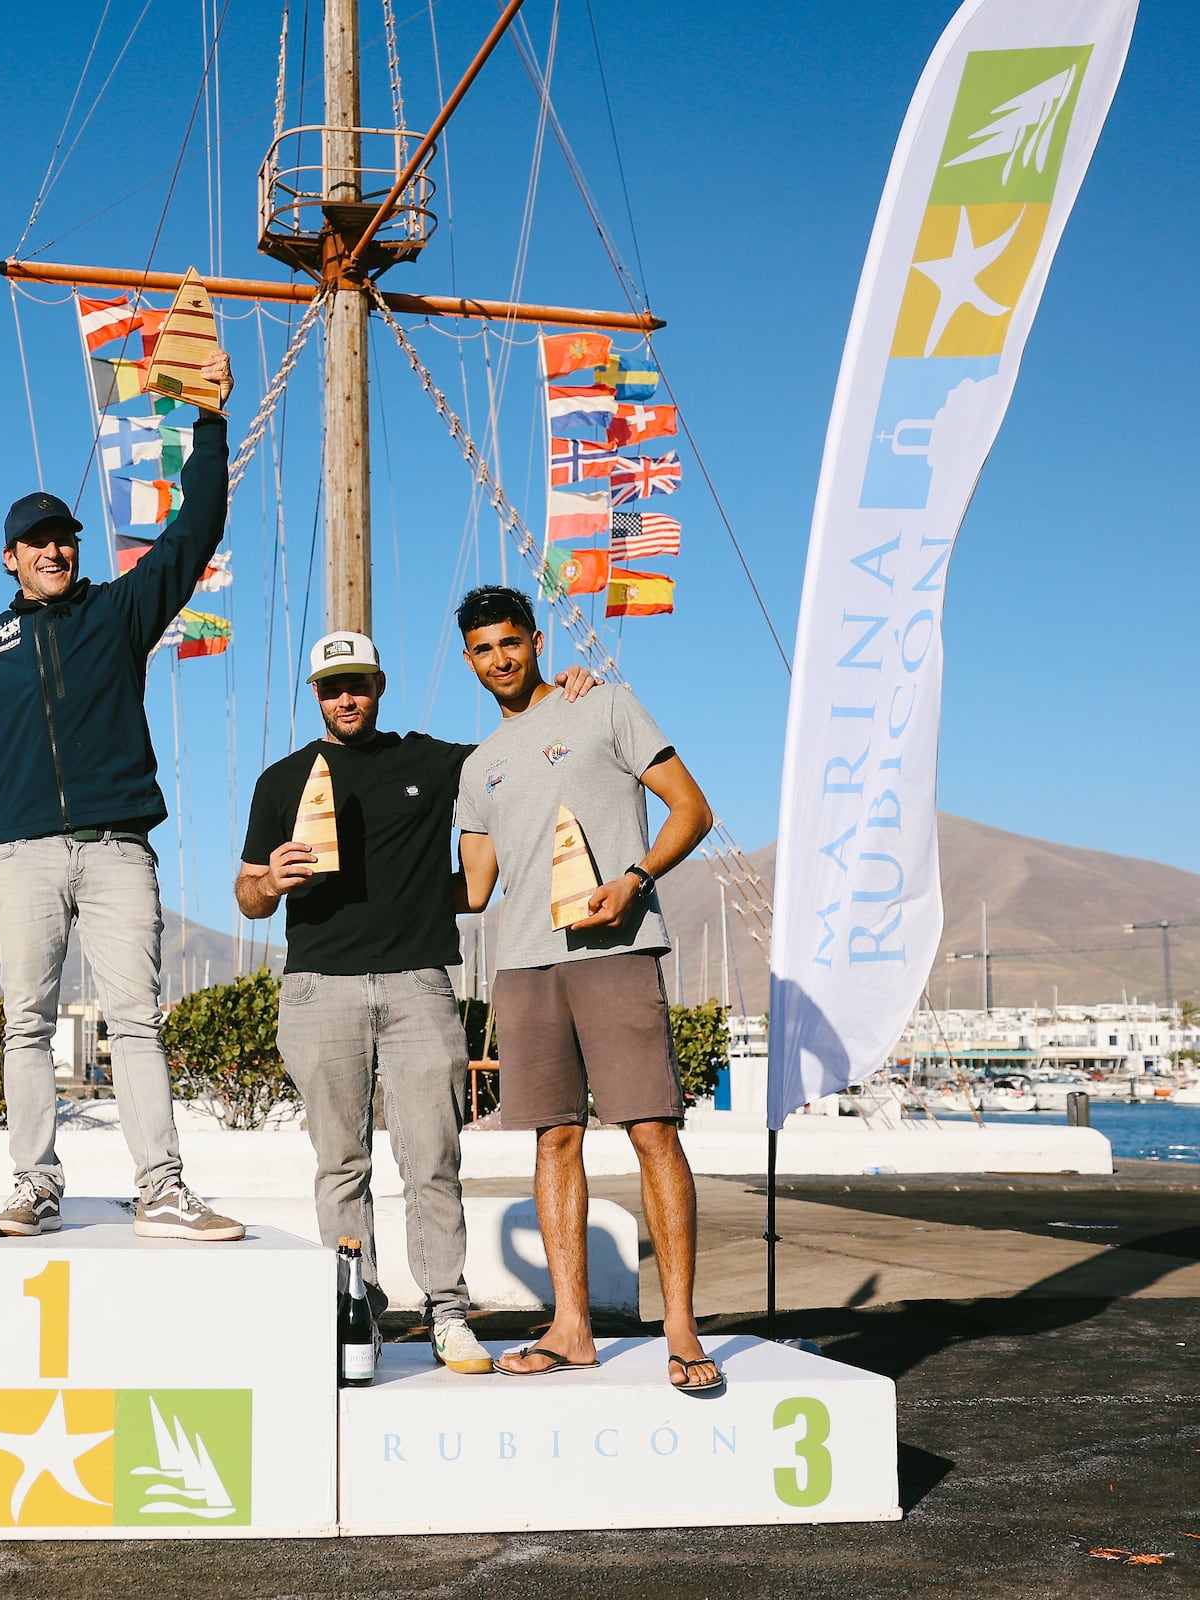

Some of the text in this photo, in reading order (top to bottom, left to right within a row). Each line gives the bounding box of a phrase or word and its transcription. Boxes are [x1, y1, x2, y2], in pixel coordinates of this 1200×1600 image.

[812, 529, 903, 970] MARINA
[848, 531, 951, 967] RUBICÓN
[23, 1260, 70, 1379] 1
[382, 1420, 738, 1463] RUBICÓN
[773, 1396, 833, 1508] 3
